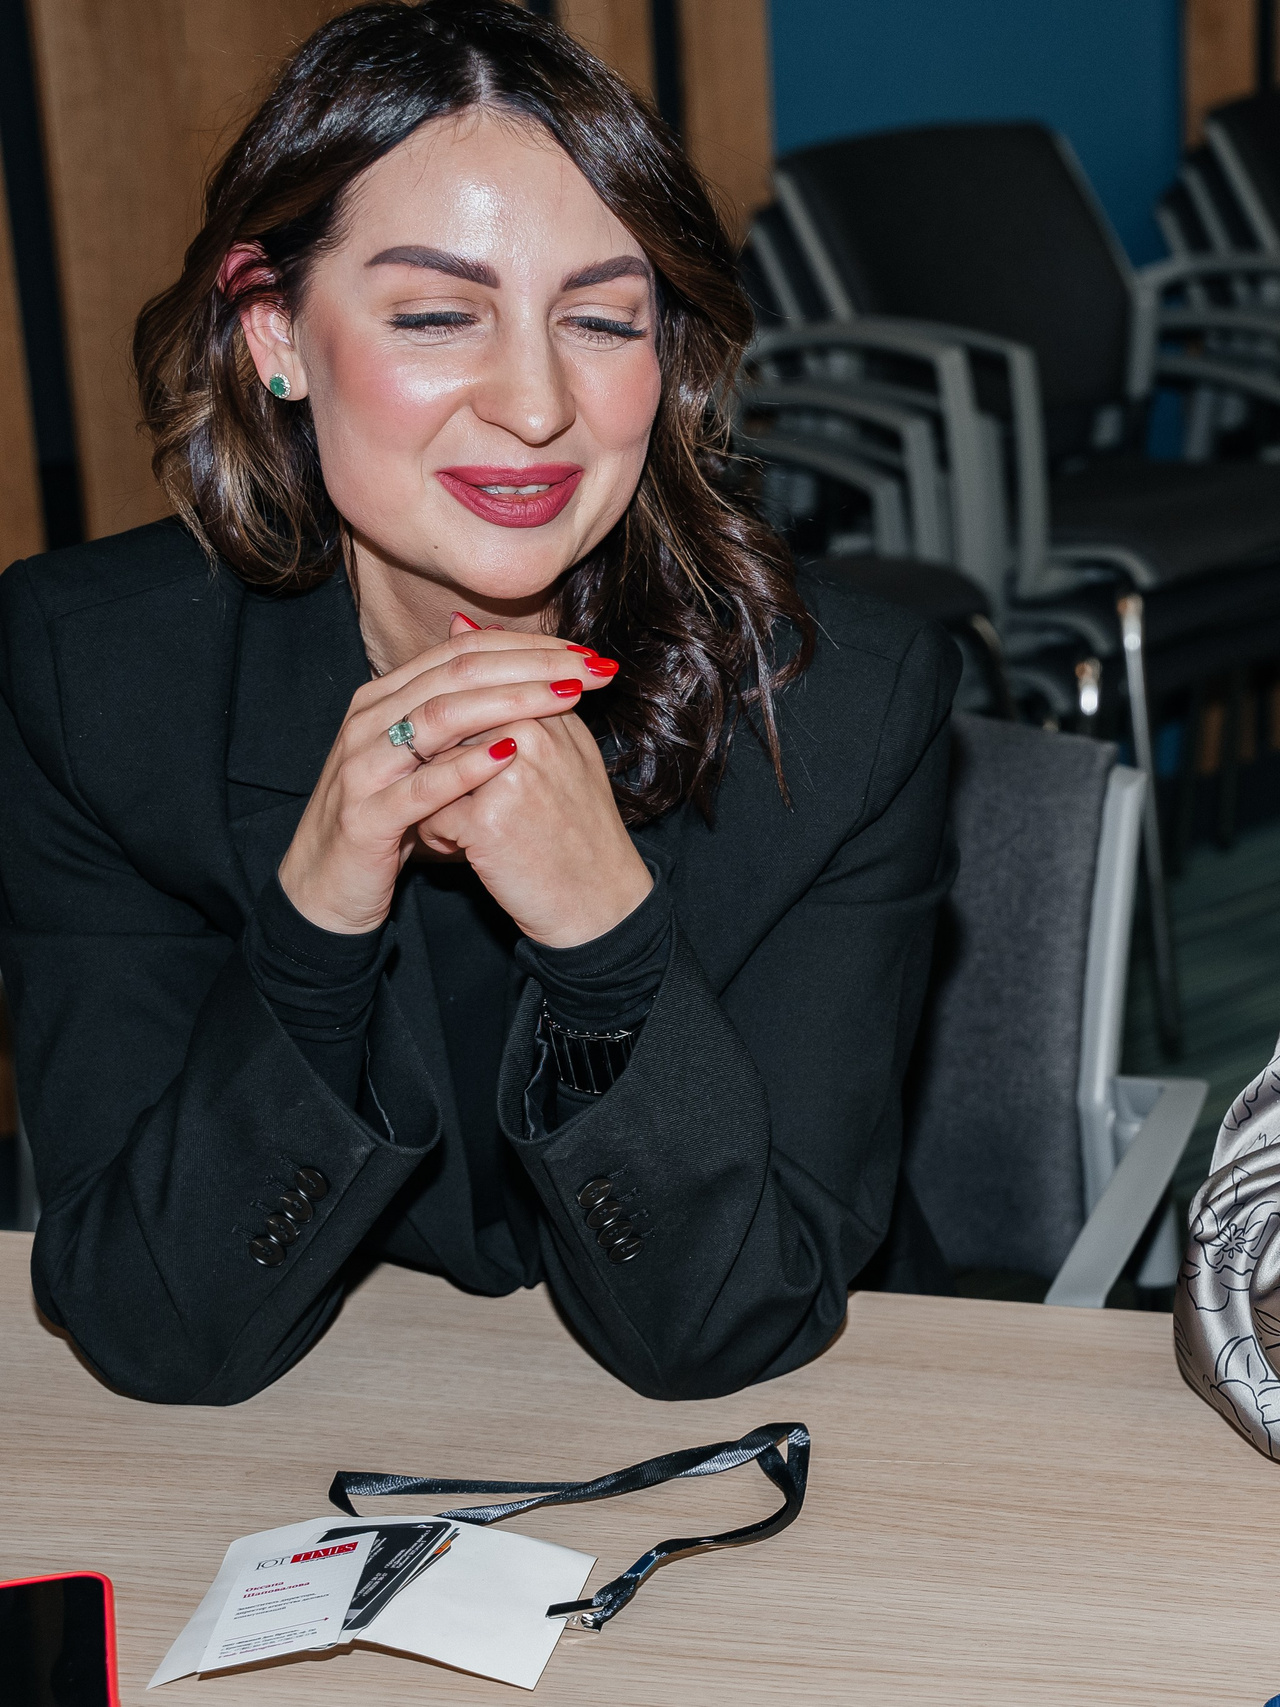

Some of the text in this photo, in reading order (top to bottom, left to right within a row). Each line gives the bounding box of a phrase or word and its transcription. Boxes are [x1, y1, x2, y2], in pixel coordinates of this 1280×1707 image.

[297, 1543, 355, 1561] TIMES
[242, 1582, 310, 1599] Шаповалова
[245, 1582, 284, 1593] Оксана
